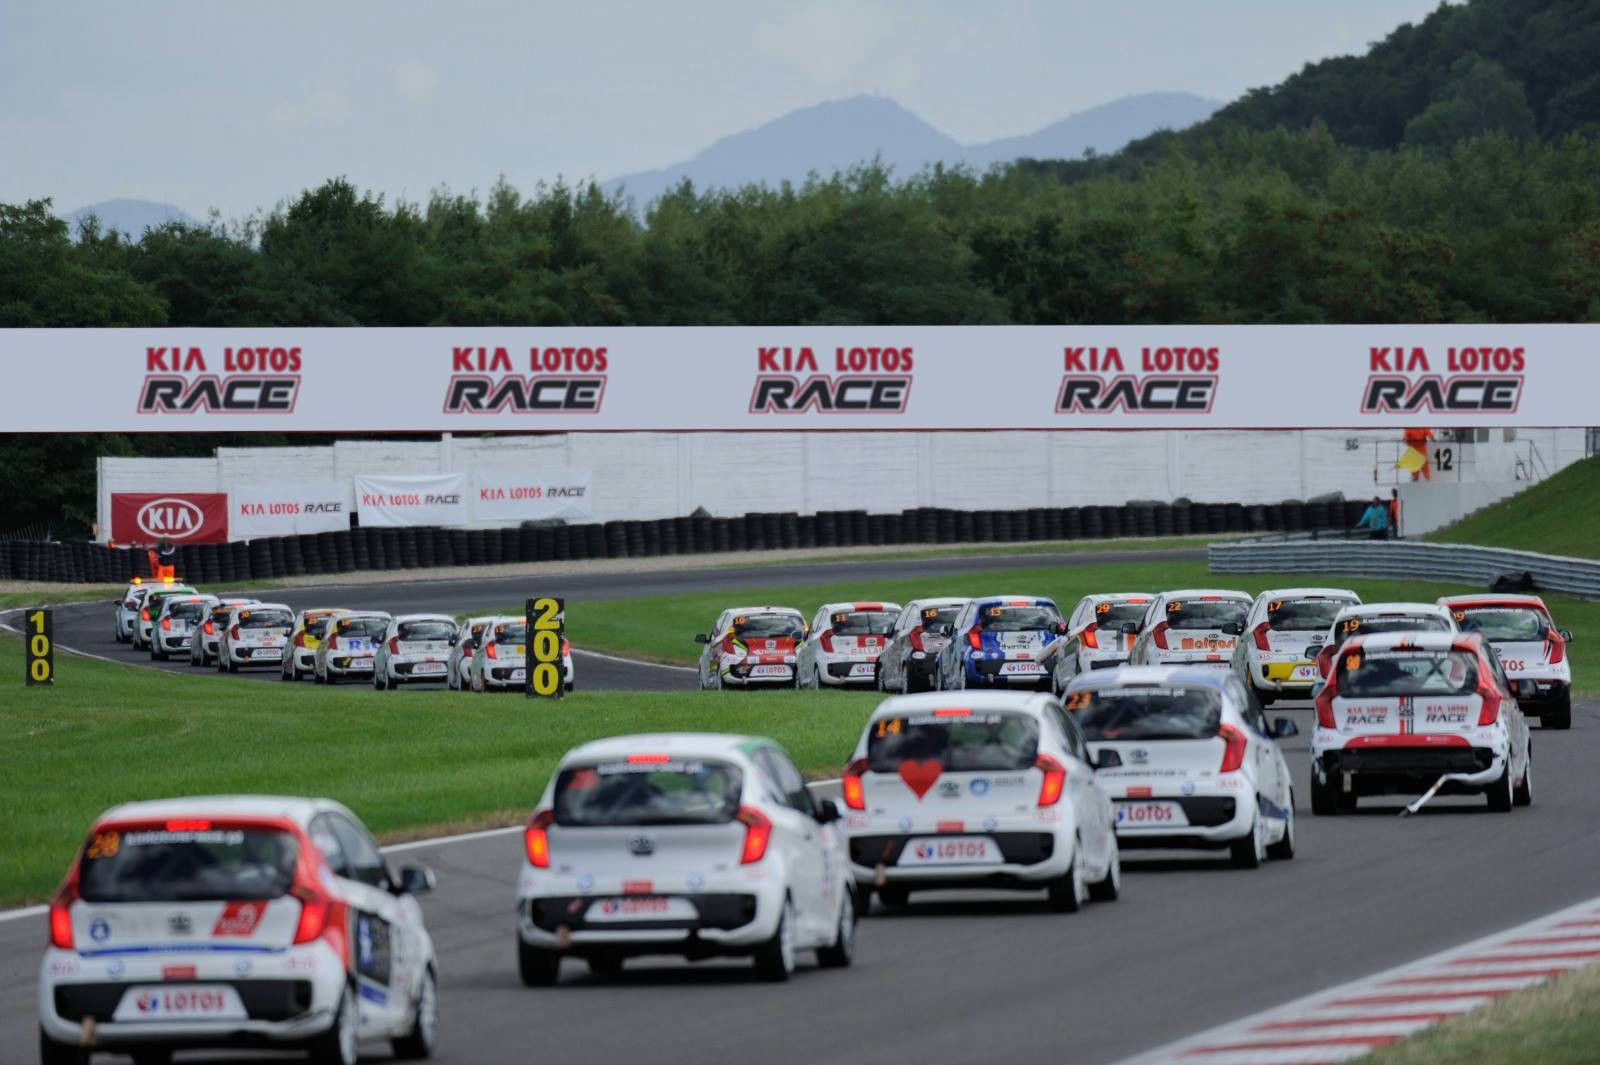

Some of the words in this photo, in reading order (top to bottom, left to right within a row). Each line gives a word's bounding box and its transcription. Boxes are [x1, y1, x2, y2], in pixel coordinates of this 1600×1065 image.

[146, 347, 206, 372] KIA
[224, 347, 301, 372] LOTOS
[452, 347, 512, 372] KIA
[530, 347, 607, 372] LOTOS
[758, 347, 818, 372] KIA
[836, 347, 913, 372] LOTOS
[1064, 347, 1124, 372] KIA
[1141, 347, 1219, 372] LOTOS
[1370, 347, 1430, 372] KIA
[1447, 347, 1525, 372] LOTOS
[142, 378, 297, 411] RACE
[448, 378, 602, 411] RACE
[753, 378, 908, 411] RACE
[1060, 378, 1214, 411] RACE
[1365, 378, 1520, 411] RACE
[1434, 448, 1453, 471] 12
[362, 494, 385, 507] KIA
[390, 494, 420, 506] LOTOS
[425, 495, 459, 504] RACE
[480, 488, 505, 500] KIA
[510, 487, 542, 499] LOTOS
[547, 486, 586, 497] RACE
[148, 508, 193, 530] KIA
[241, 503, 264, 515] KIA
[269, 503, 300, 515] LOTOS
[304, 503, 342, 513] RACE
[924, 608, 938, 619] 16
[1096, 603, 1111, 614] 29
[1167, 602, 1182, 612] 22
[1269, 601, 1282, 612] 17
[734, 616, 747, 626] 10
[834, 613, 847, 624] 11
[1342, 619, 1360, 632] 19
[30, 611, 50, 681] 100
[533, 598, 560, 696] 200
[766, 666, 787, 674] LOTOS
[876, 719, 901, 738] 14
[1128, 806, 1173, 821] LOTOS
[938, 841, 986, 859] LOTOS
[163, 990, 225, 1013] LOTOS
